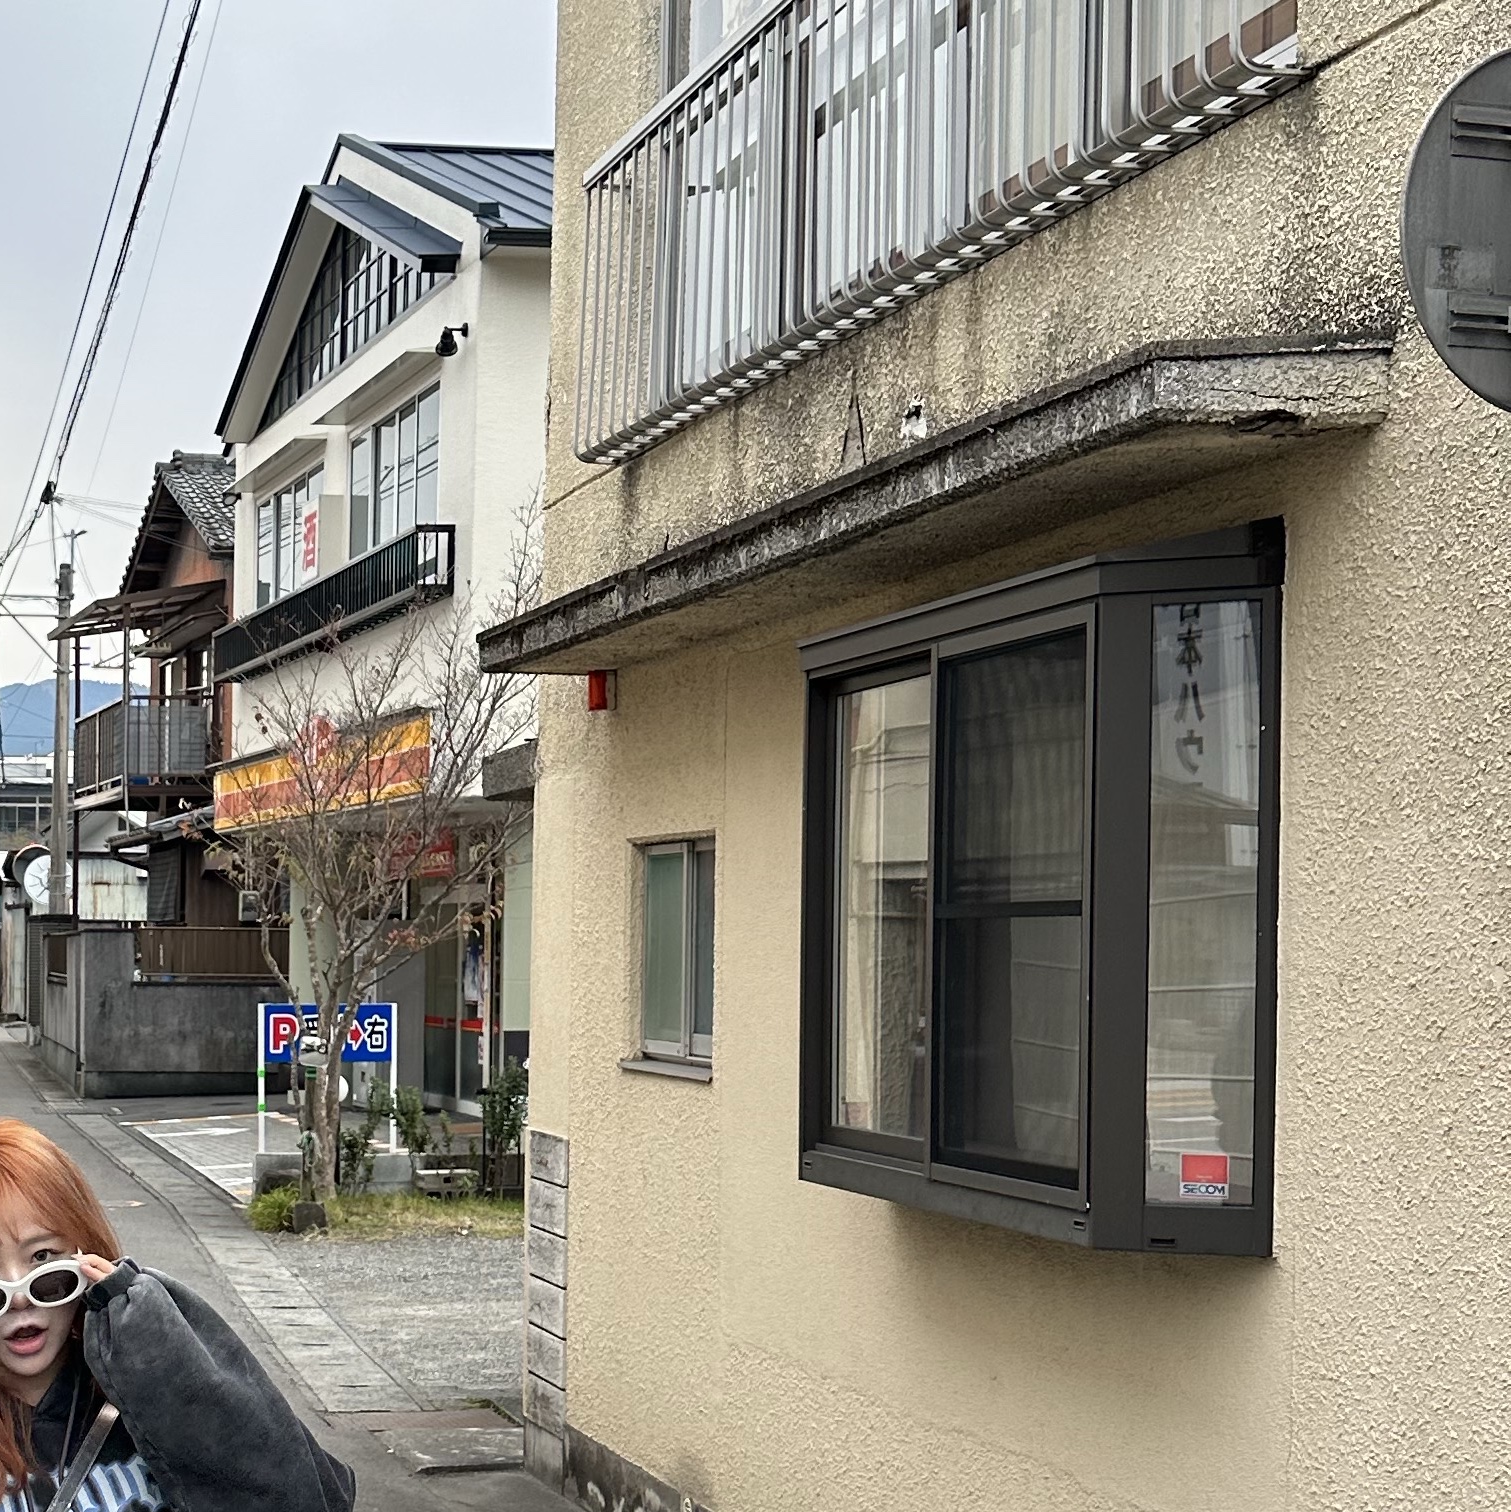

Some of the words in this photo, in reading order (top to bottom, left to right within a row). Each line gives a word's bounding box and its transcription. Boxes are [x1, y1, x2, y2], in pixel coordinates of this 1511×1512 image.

[271, 1015, 298, 1052] P
[365, 1016, 386, 1051] 右
[1183, 1184, 1225, 1195] SECOM
